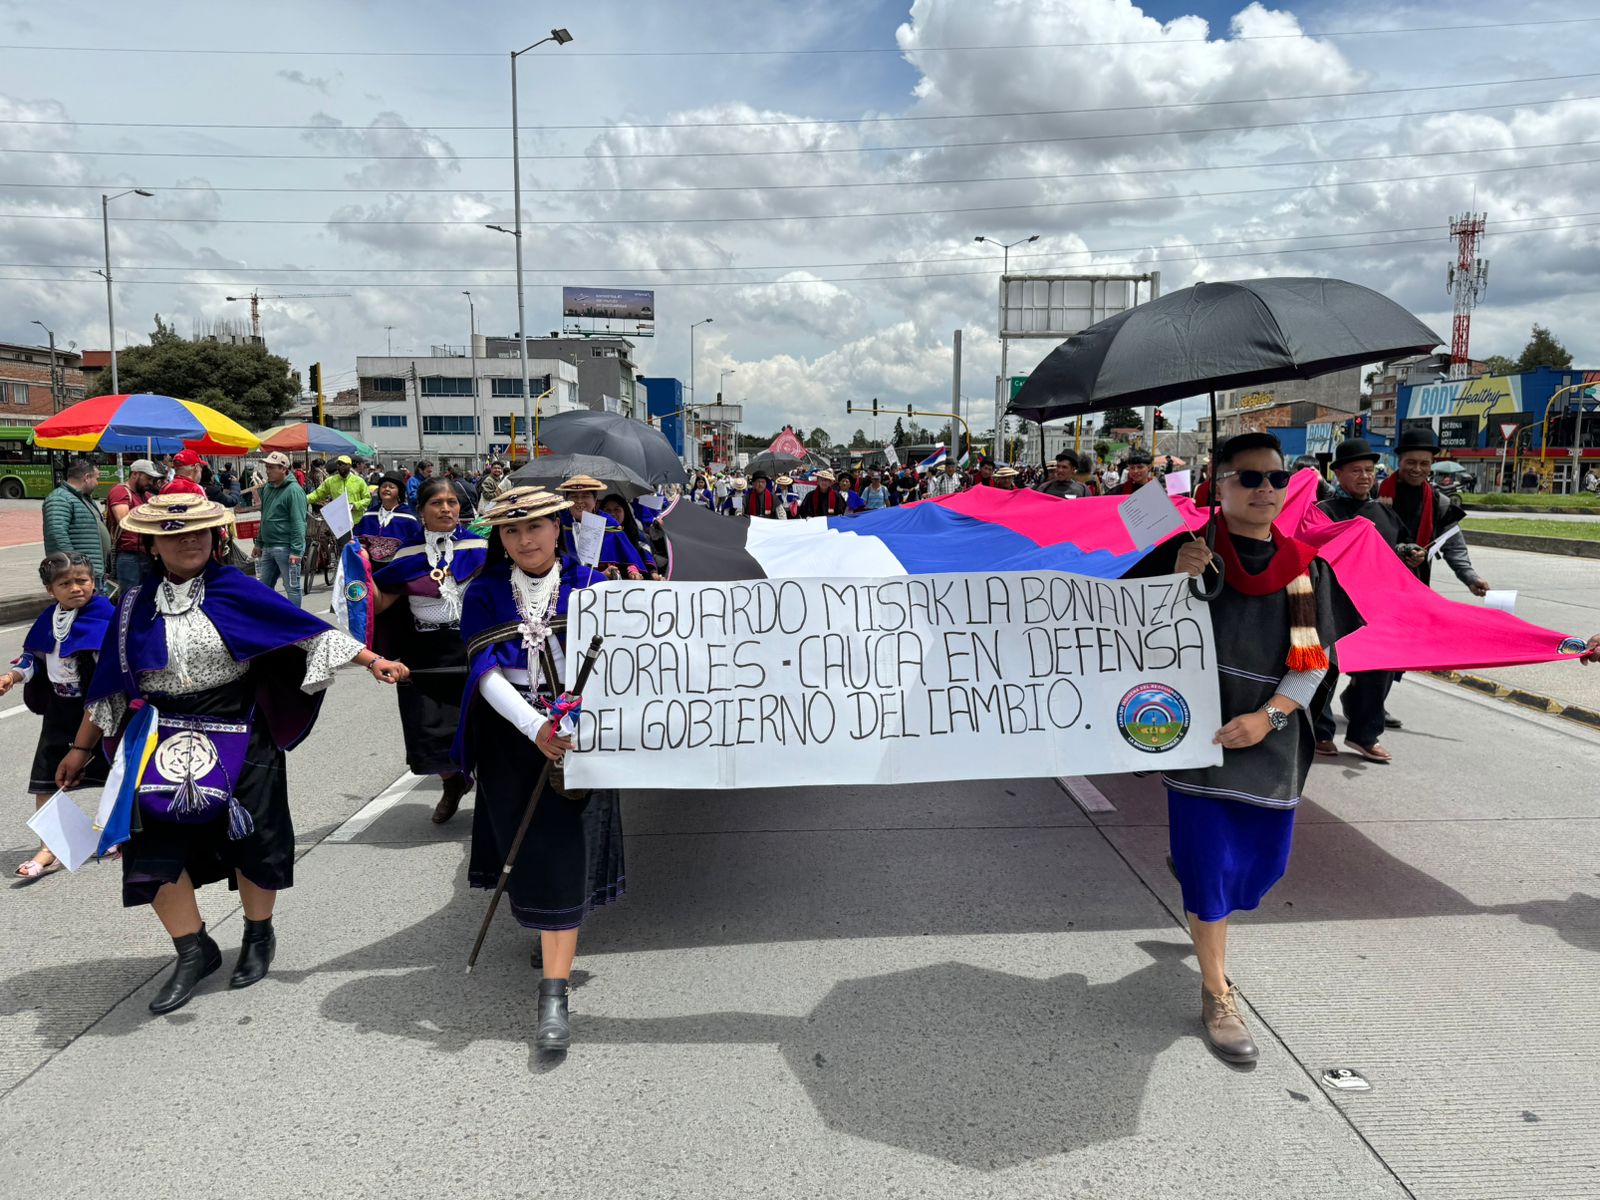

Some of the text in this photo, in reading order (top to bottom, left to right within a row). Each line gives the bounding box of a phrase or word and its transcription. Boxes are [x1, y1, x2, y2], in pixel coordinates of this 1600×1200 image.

[1419, 381, 1510, 418] BODY Healthy
[578, 576, 1195, 640] RESGUARDO MISAK LA BONANZA
[799, 631, 926, 689] CAUCA
[944, 630, 1002, 682] EN
[1022, 618, 1205, 678] DEFENSA
[573, 678, 1091, 752] DEL GOBIERNO DEL CAMBIO.
